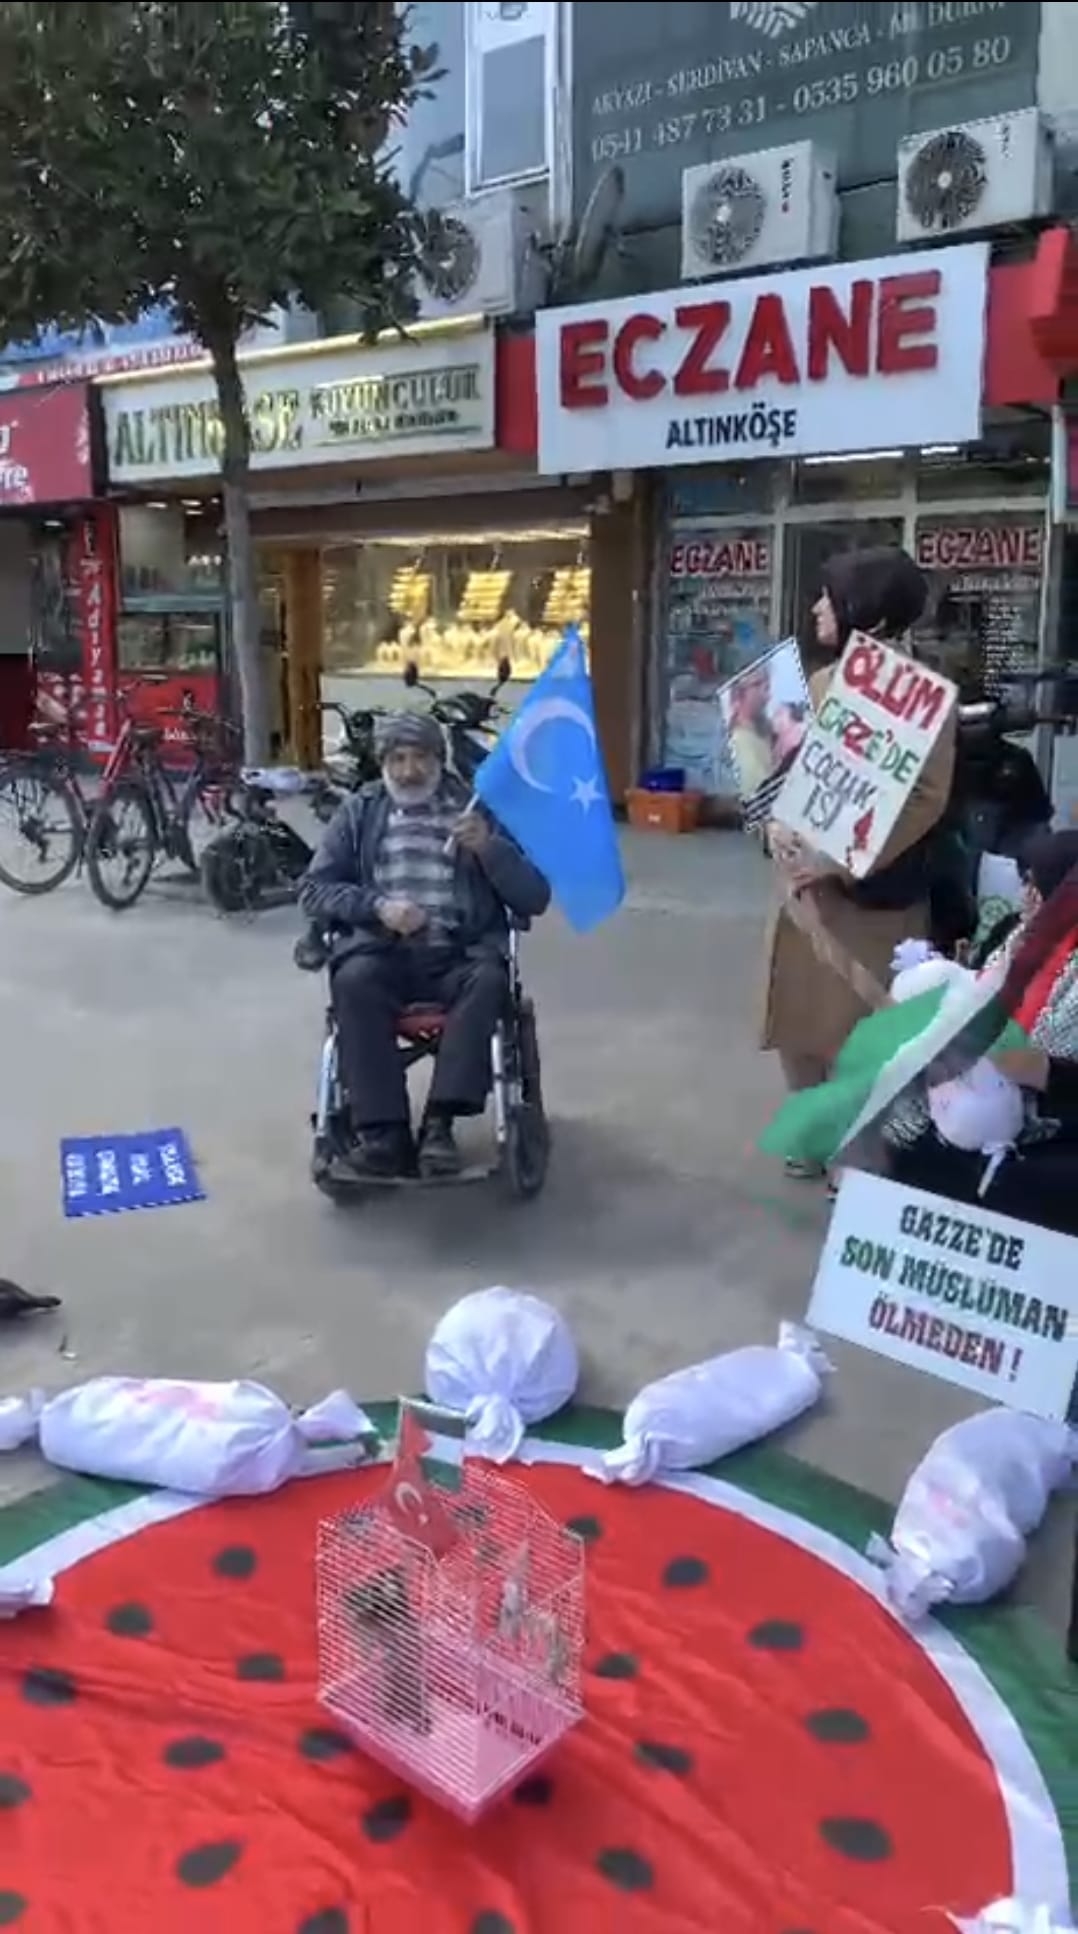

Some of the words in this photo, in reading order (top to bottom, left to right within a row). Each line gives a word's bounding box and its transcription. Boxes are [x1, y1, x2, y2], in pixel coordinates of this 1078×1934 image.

[702, 104, 731, 133] 73
[738, 96, 765, 124] 31
[793, 72, 858, 113] 0535
[867, 55, 918, 94] 960
[928, 46, 962, 79] 05
[973, 35, 1010, 69] 80
[559, 269, 942, 409] ECZANE
[665, 402, 797, 450] ALTINKÖŞE
[671, 541, 769, 576] ECZANE
[918, 528, 1042, 568] ECZANE
[843, 635, 946, 730] ÖLÜM
[900, 1203, 1025, 1271] GAZZE'DE
[840, 1235, 896, 1281] SON
[898, 1254, 1069, 1342] MÜSLÜMAN
[868, 1290, 1005, 1376] ÖLMEDEN
